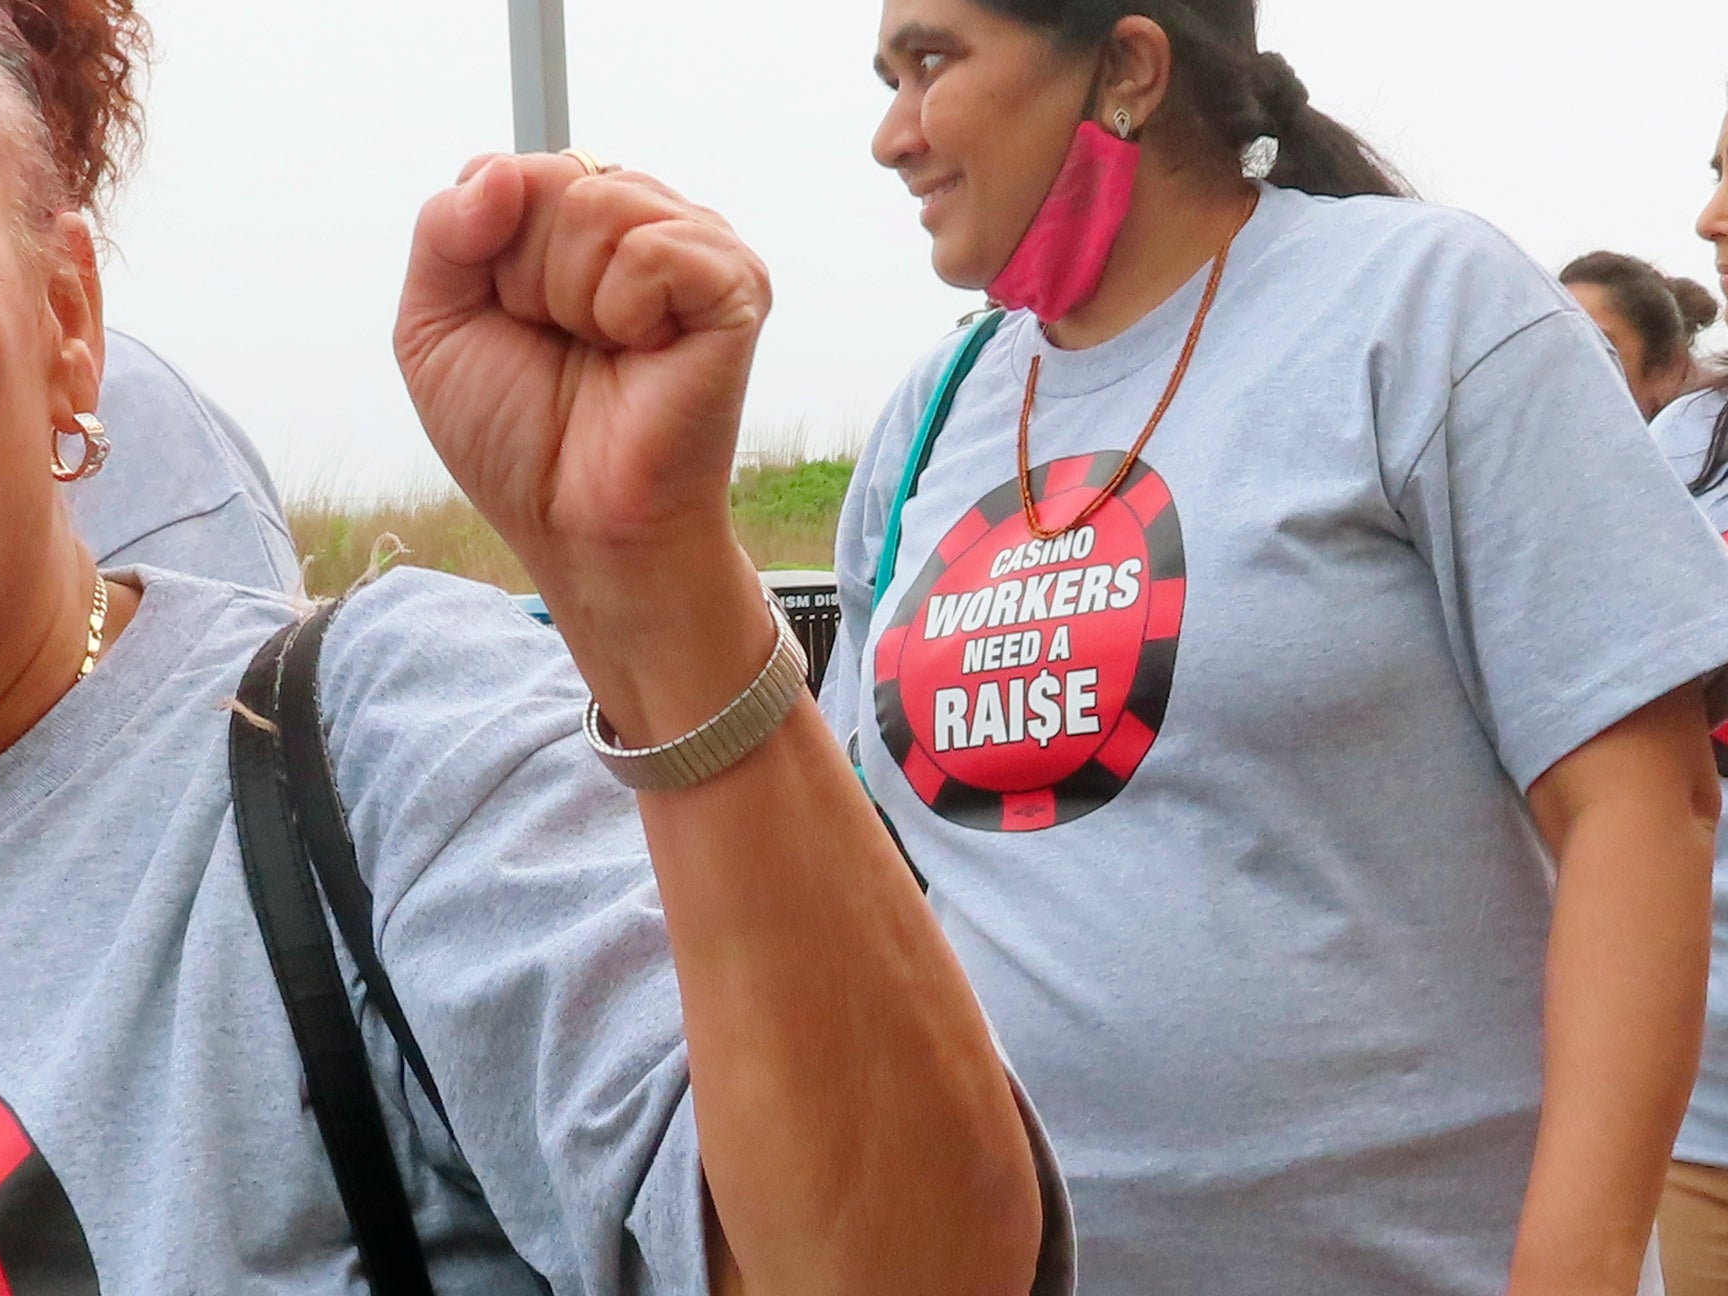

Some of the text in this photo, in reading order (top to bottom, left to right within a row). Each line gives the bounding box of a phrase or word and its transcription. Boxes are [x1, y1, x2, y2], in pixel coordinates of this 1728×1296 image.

[989, 525, 1096, 580] CASINO
[923, 558, 1143, 641] WORKERS
[961, 625, 1071, 675] NEED A
